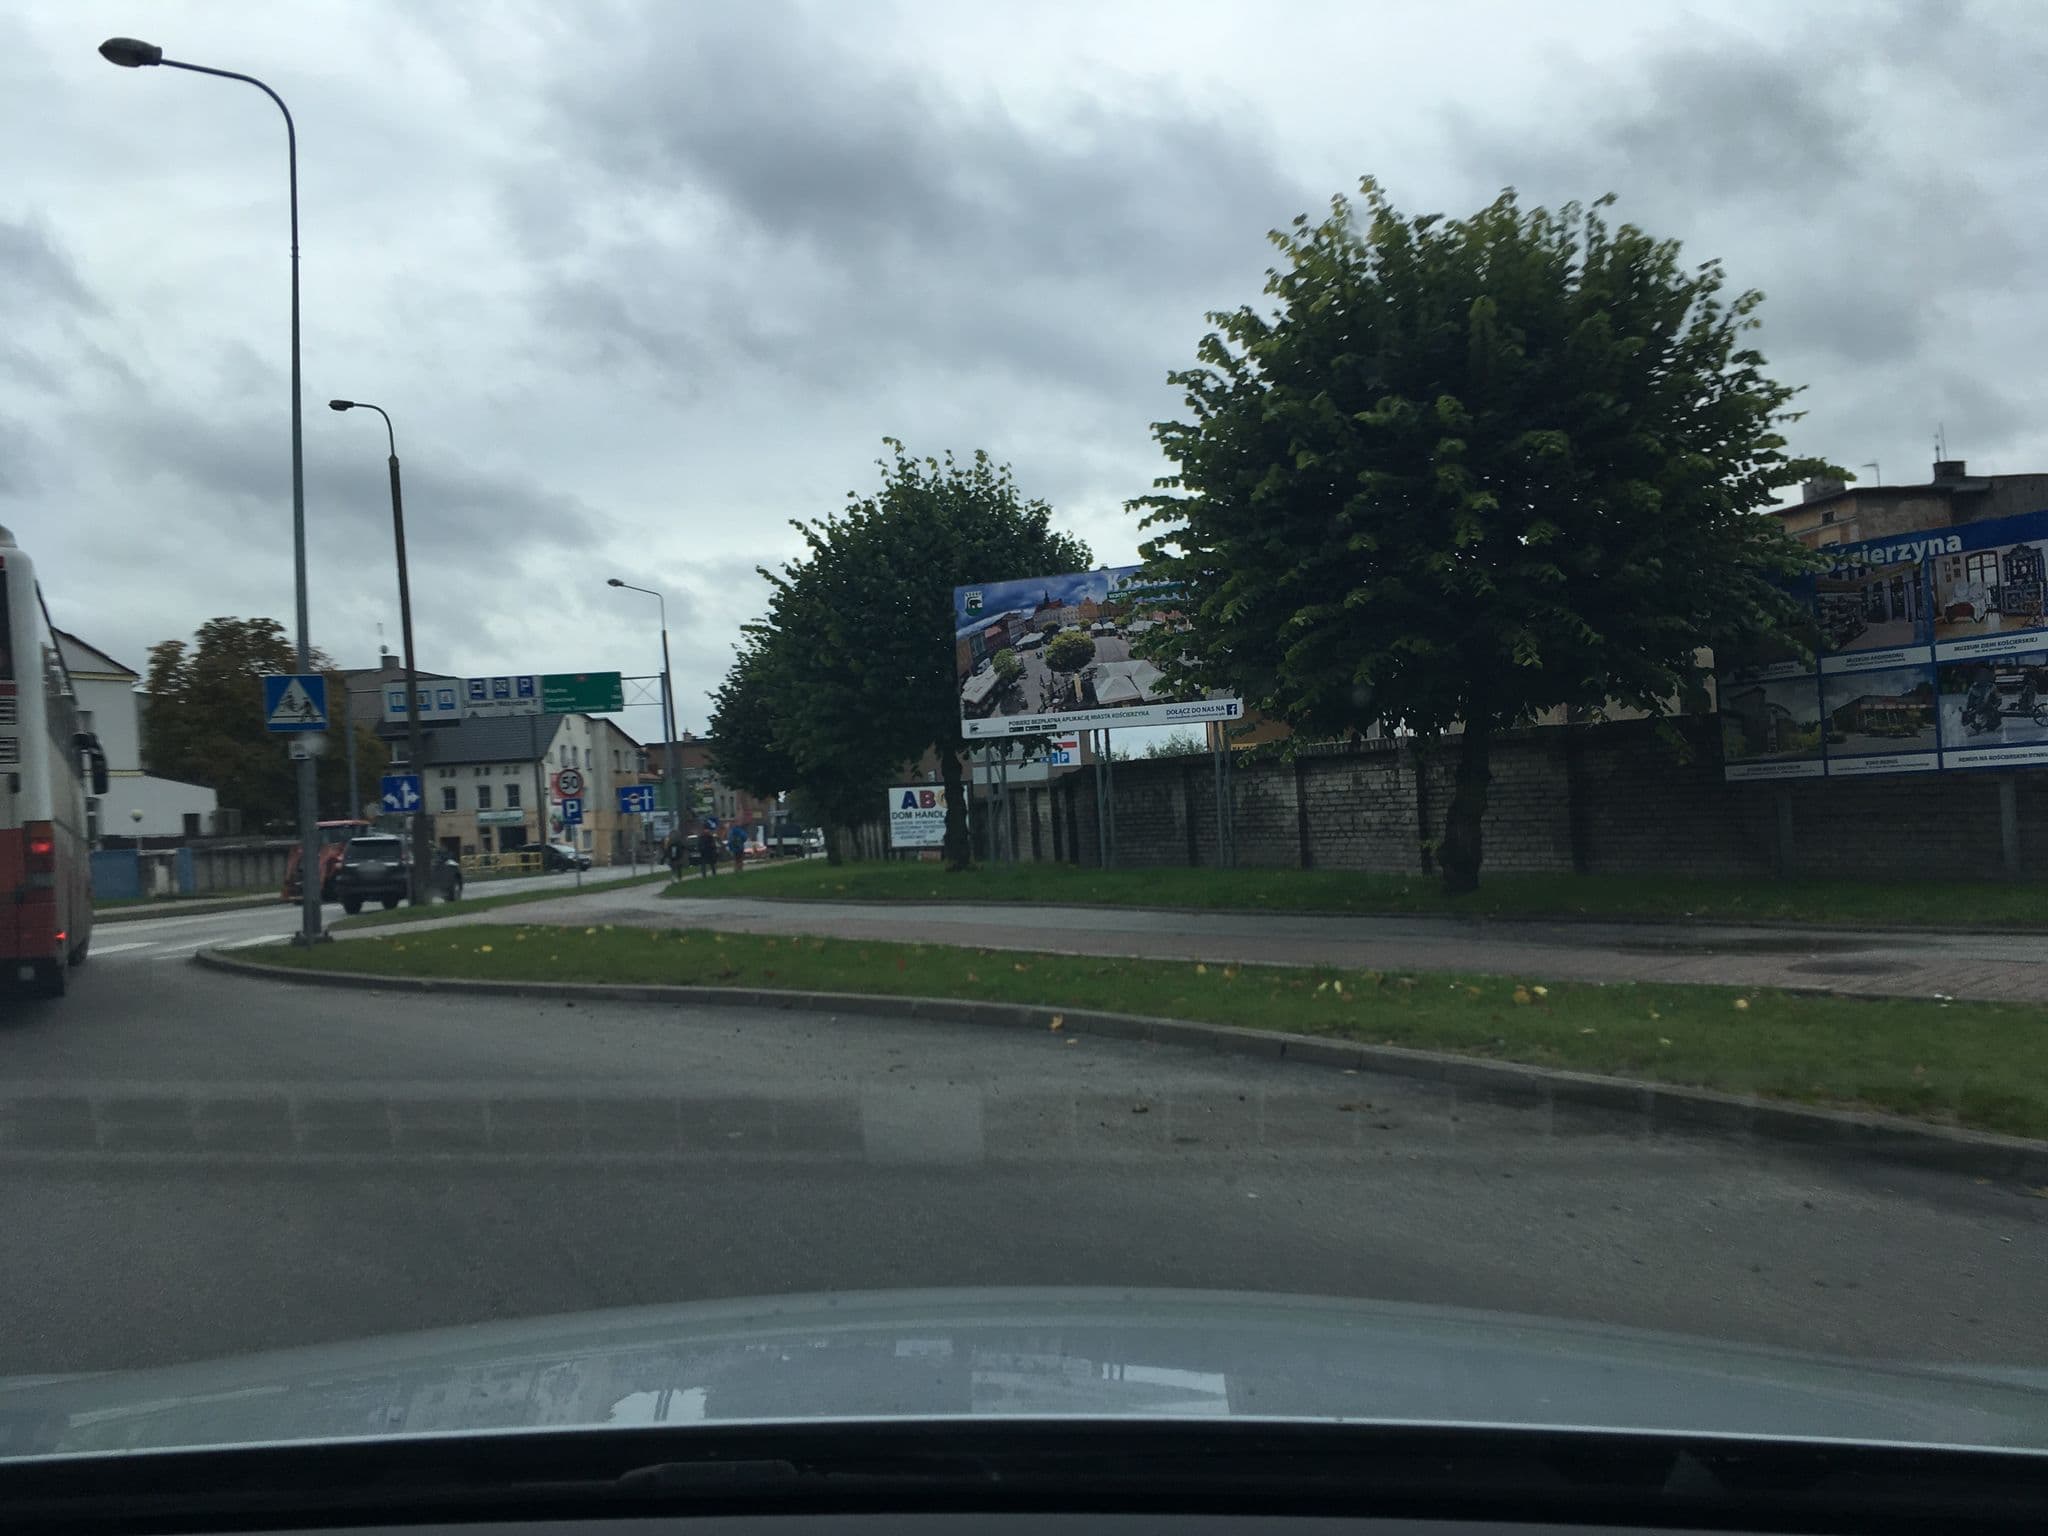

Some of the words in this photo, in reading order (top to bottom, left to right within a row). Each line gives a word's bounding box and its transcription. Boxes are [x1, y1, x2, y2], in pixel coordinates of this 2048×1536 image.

[1166, 708, 1190, 717] DOŁĄCZ
[562, 775, 578, 790] 50
[892, 811, 912, 820] DOM
[914, 810, 945, 819] HANDL
